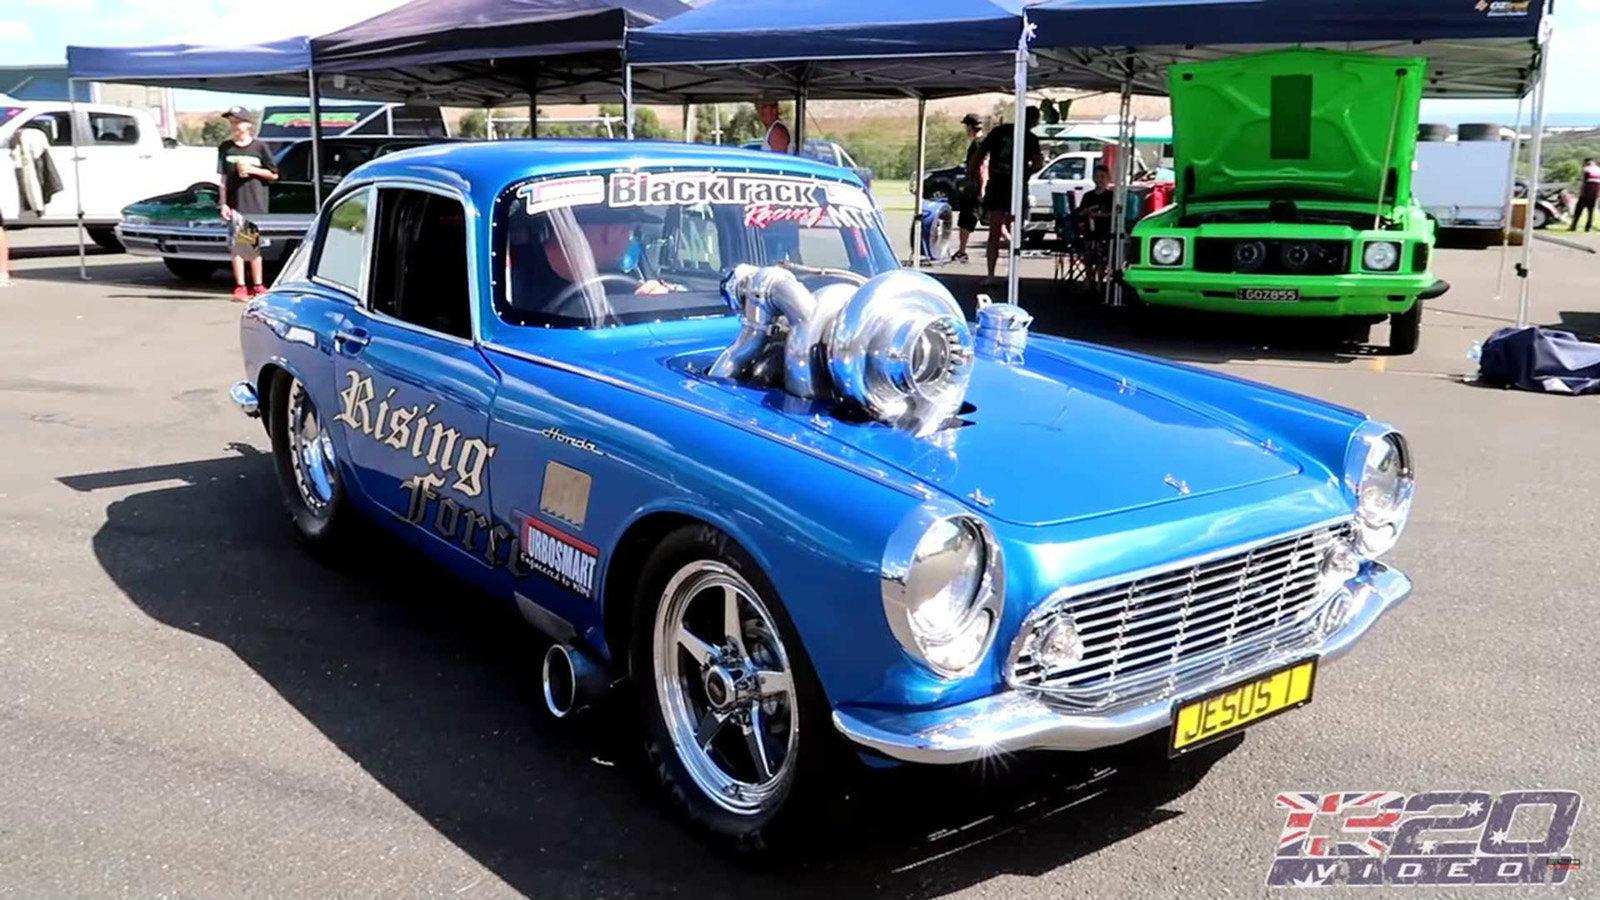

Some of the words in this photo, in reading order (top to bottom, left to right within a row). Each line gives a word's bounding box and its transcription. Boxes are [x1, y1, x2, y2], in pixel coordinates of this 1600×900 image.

[745, 202, 827, 229] Racing
[334, 370, 496, 497] Rising
[541, 427, 604, 456] Honda
[1184, 677, 1274, 741] JESUS
